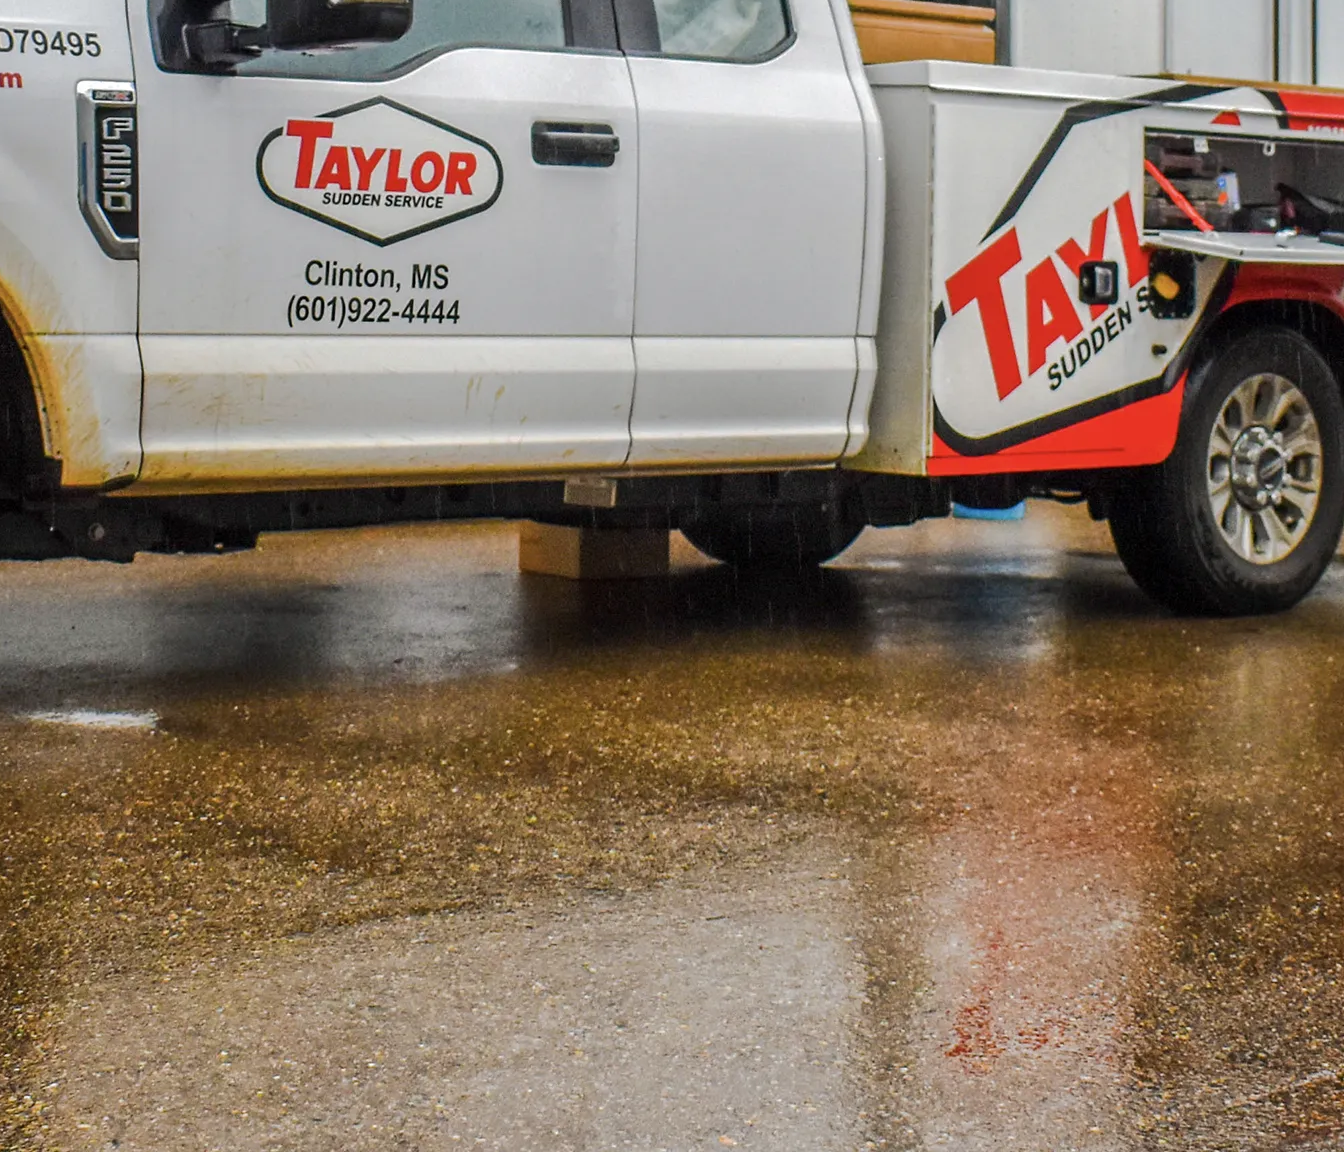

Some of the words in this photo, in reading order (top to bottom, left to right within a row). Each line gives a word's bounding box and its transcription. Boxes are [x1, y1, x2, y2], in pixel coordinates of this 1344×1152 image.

[101, 116, 134, 212] F250
[286, 119, 477, 195] TAYLOR
[322, 192, 380, 207] SUDDEN
[384, 195, 444, 209] SERVICE
[287, 294, 460, 328] (601)922-4444
[305, 259, 401, 292] Clinton,
[411, 264, 449, 289] MS
[944, 190, 1151, 402] TAYL
[1047, 301, 1132, 391] SUDDEN
